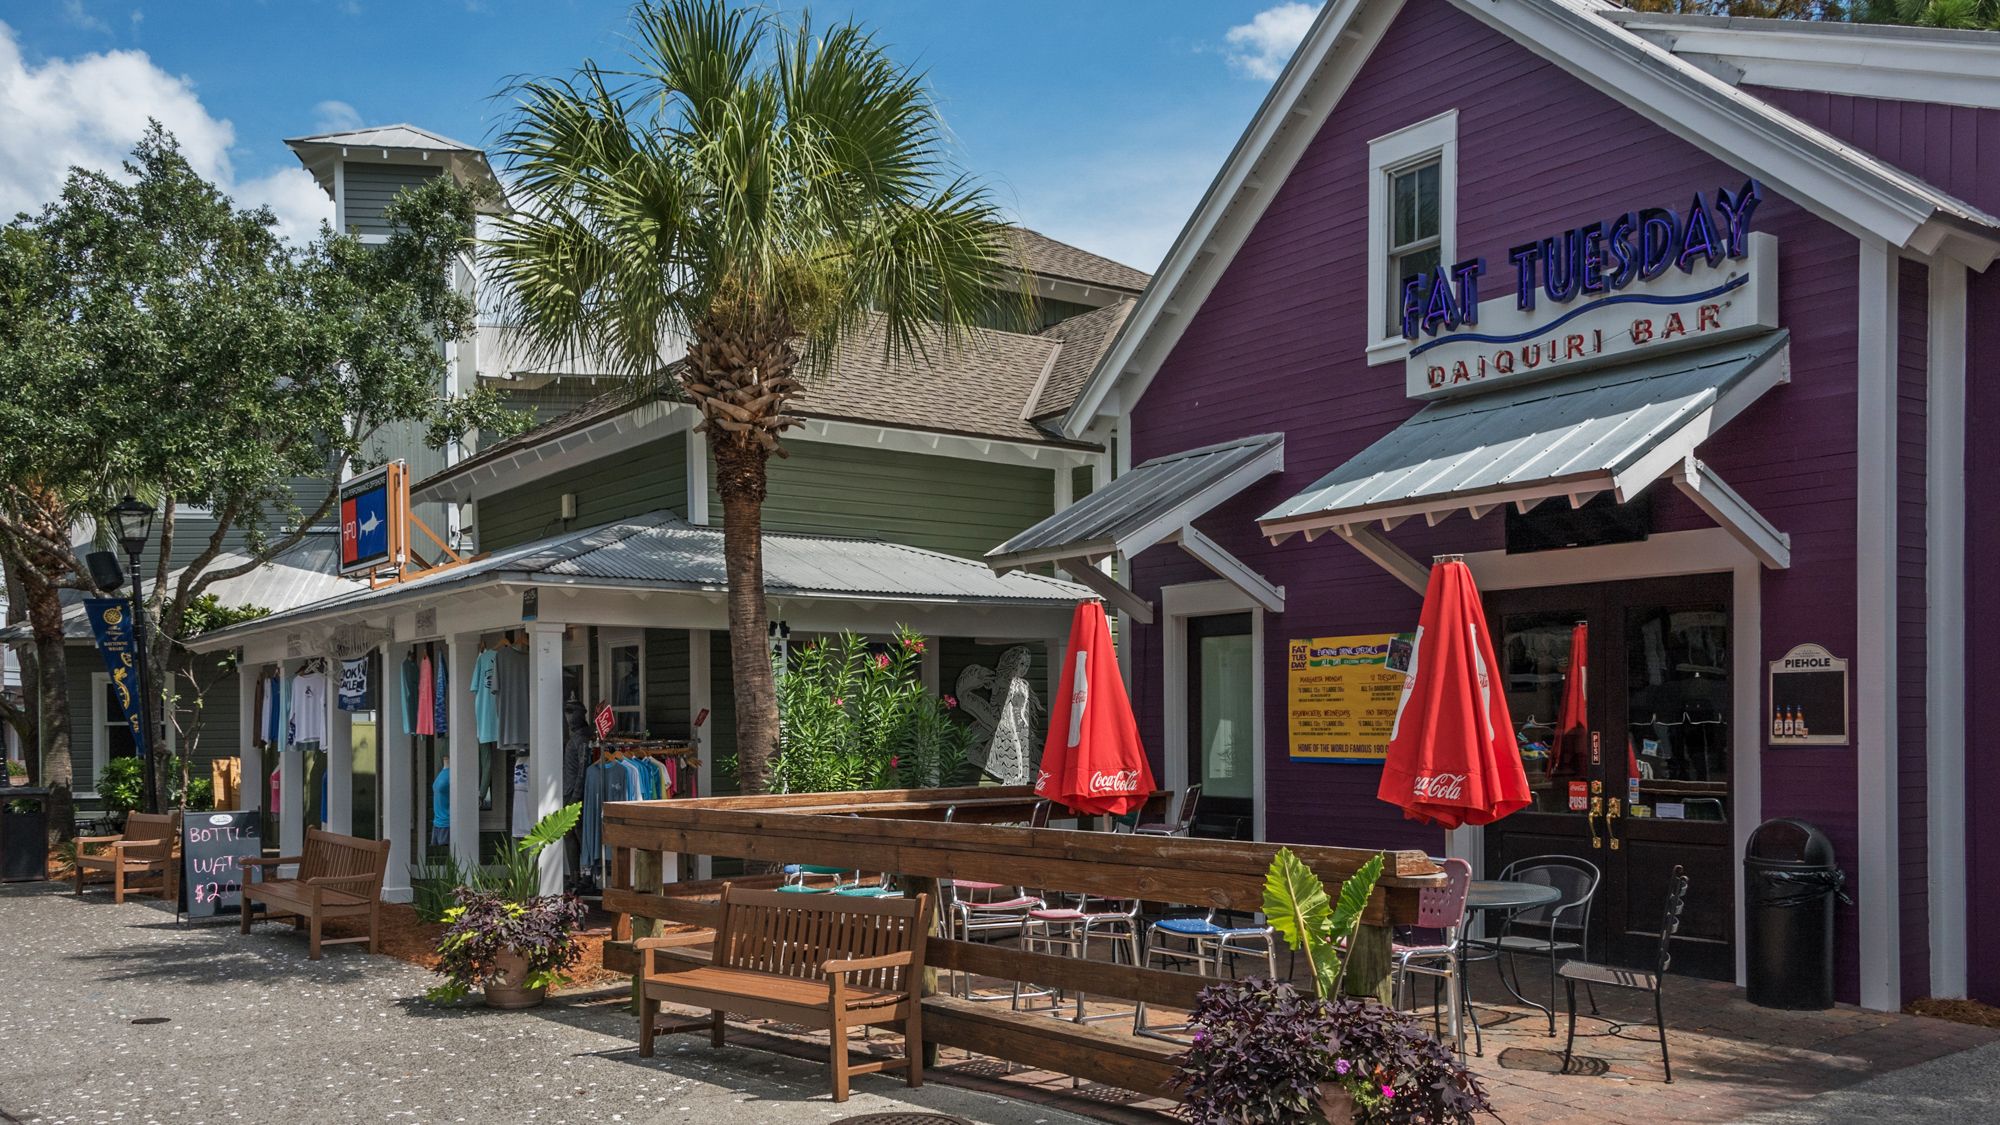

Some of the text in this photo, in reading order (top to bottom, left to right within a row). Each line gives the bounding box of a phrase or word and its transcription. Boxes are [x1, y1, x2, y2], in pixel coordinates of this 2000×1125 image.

[1401, 179, 1762, 340] FAT TUESDAY
[1428, 303, 1724, 389] DAIQUIRI BAR
[1785, 658, 1831, 668] PIEHOLE
[600, 712, 611, 735] Sale
[1297, 743, 1312, 752] HOME
[1312, 743, 1319, 752] OF
[1320, 744, 1330, 752] THE
[1330, 744, 1349, 753] WORLD
[1349, 744, 1372, 753] FAMOUS
[1090, 769, 1141, 792] Coca-Cola
[1414, 773, 1467, 800] ca-Cola
[1569, 796, 1588, 810] PUSH
[189, 825, 254, 843] BOTTLE
[194, 879, 243, 904] $2.0
